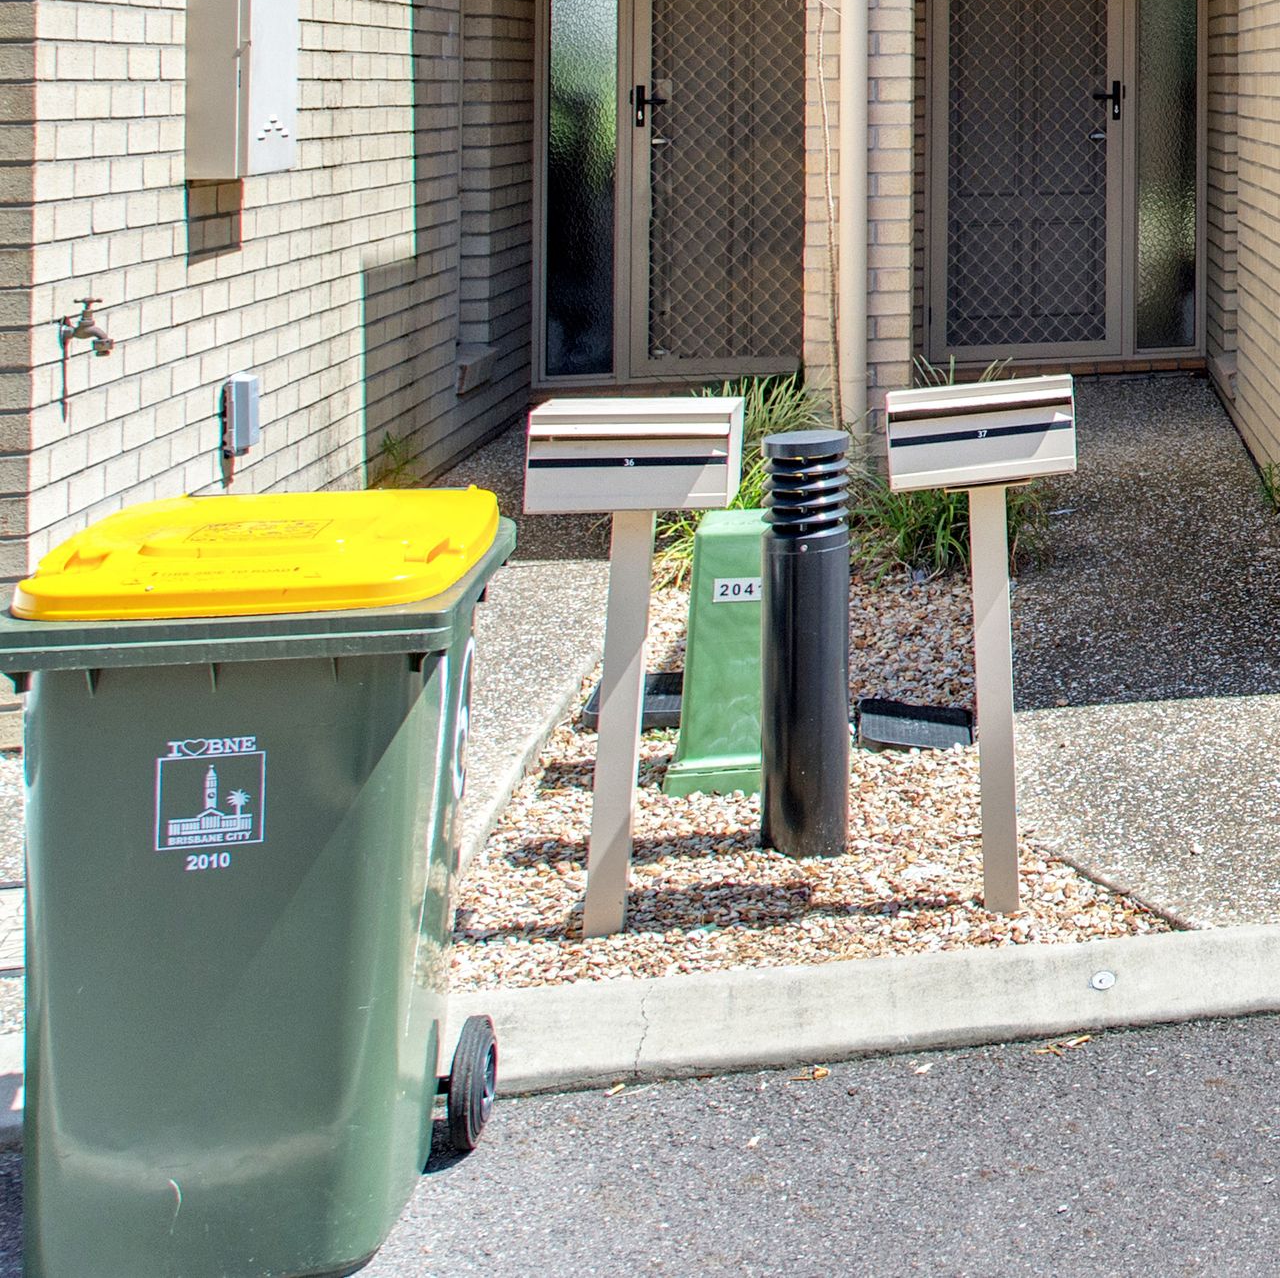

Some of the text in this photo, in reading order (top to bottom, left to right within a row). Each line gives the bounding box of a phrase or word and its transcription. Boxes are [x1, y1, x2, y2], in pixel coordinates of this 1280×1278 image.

[977, 429, 988, 438] 37
[623, 458, 635, 467] 36
[719, 582, 763, 597] 204
[167, 830, 253, 846] BRISBANE CITY
[185, 852, 231, 871] 2010
